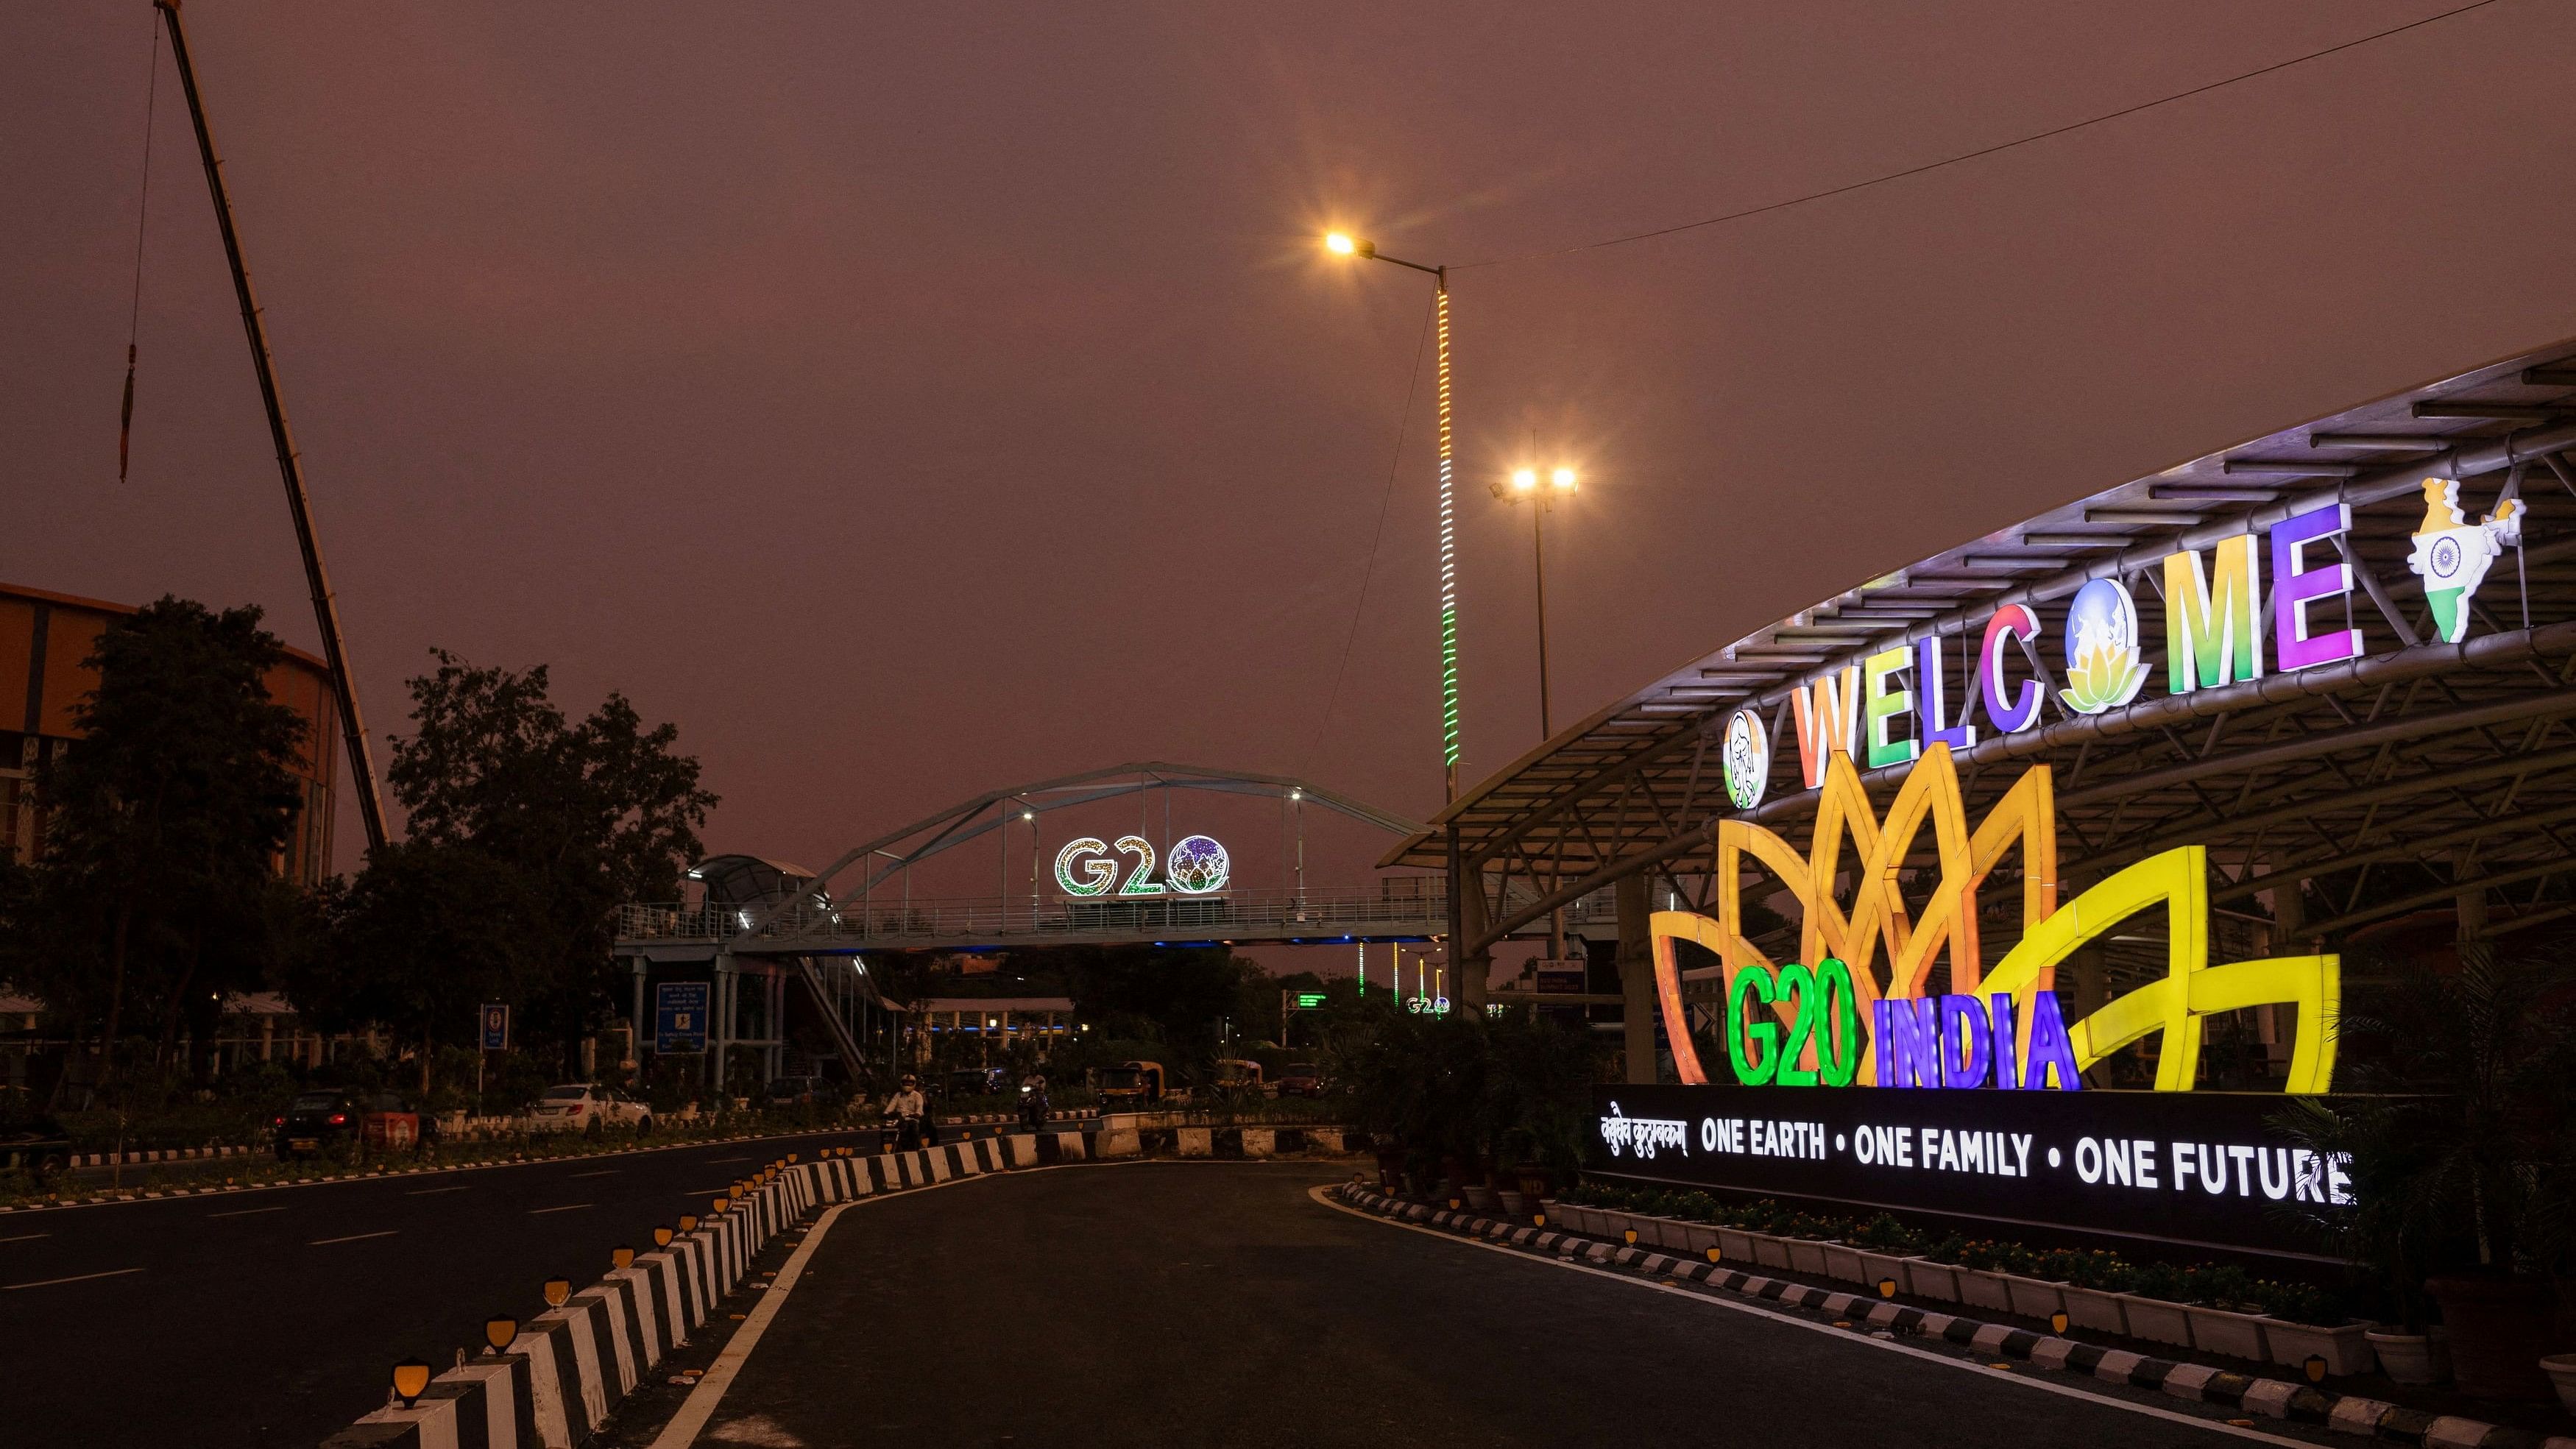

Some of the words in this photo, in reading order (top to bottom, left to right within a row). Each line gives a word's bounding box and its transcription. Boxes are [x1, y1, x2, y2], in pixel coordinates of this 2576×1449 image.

[1791, 503, 2365, 789] WELCOME
[1054, 835, 1231, 896] G20
[1727, 958, 1858, 1087] G20
[1873, 991, 2083, 1091] INDIA
[1701, 1117, 1744, 1154] ONE
[1749, 1119, 1825, 1161] EARTH
[1854, 1124, 1913, 1167] ONE
[1921, 1128, 2033, 1177] FAMILY
[2075, 1136, 2158, 1189] ONE
[2172, 1142, 2358, 1205] FUTURE
